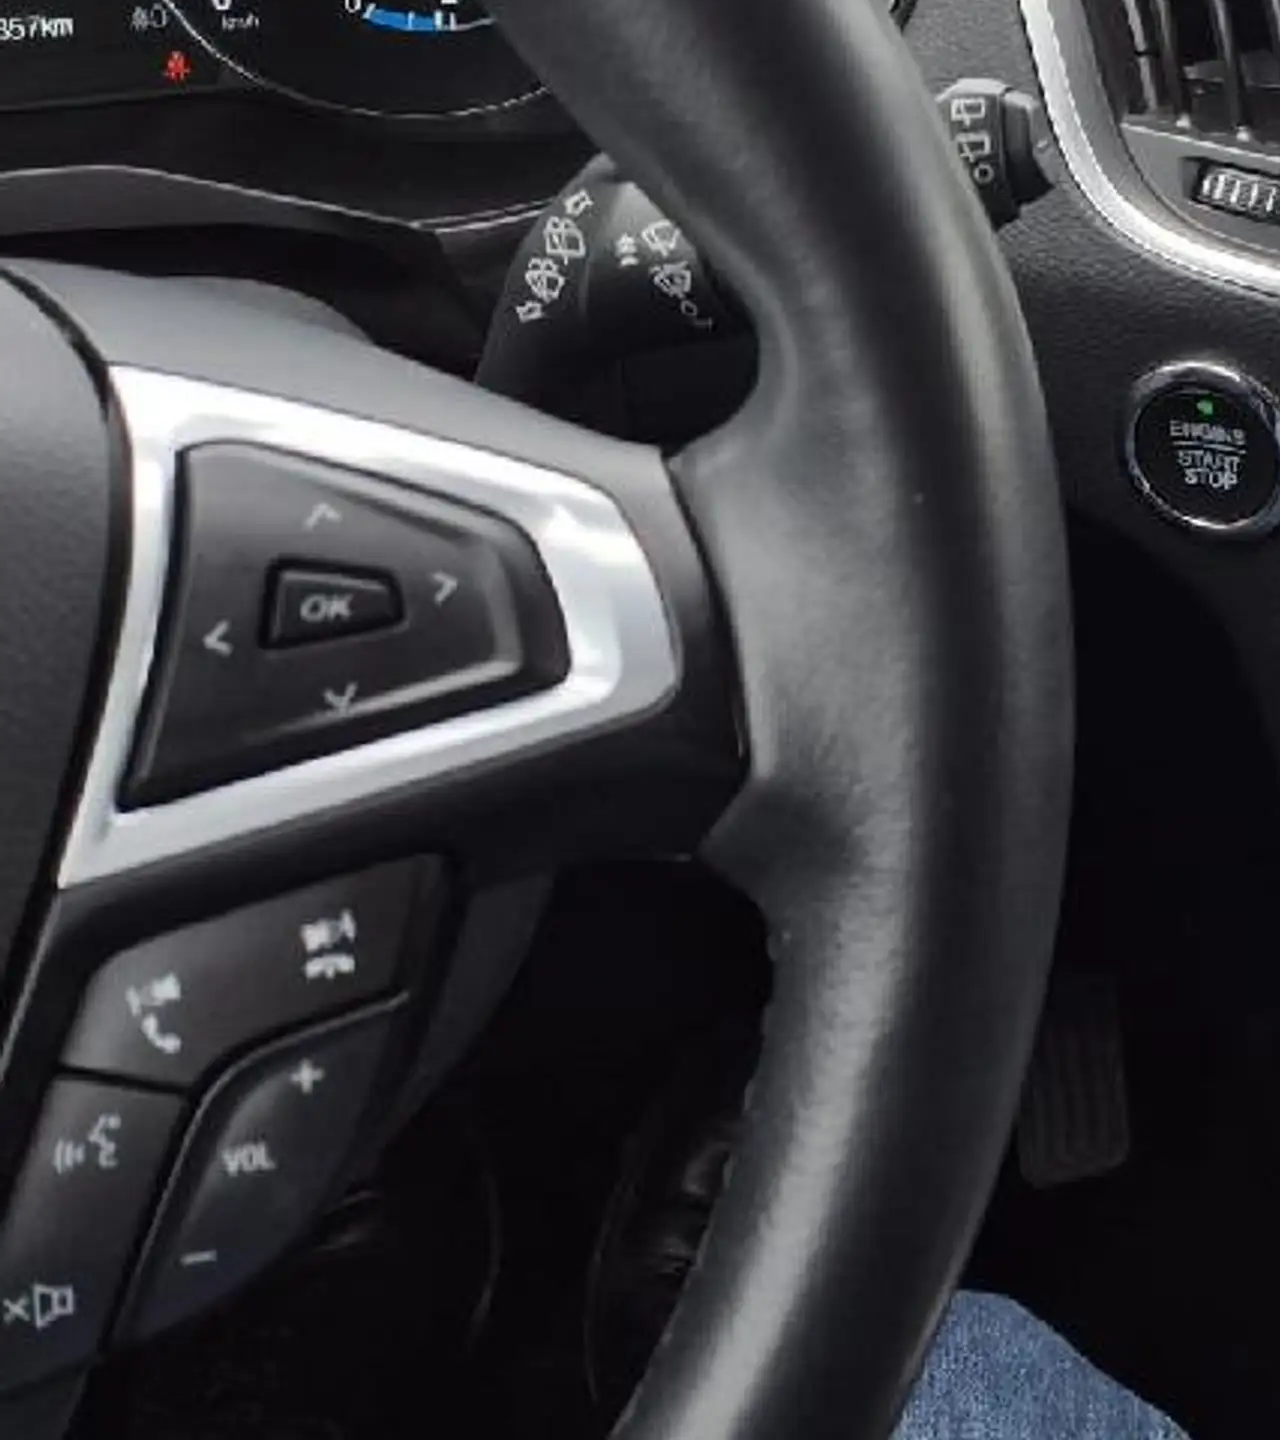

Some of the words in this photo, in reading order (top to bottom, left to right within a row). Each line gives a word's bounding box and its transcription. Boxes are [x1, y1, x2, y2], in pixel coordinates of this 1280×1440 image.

[1184, 469, 1239, 490] STOP
[299, 592, 356, 621] OK
[221, 1142, 278, 1177] VOL
